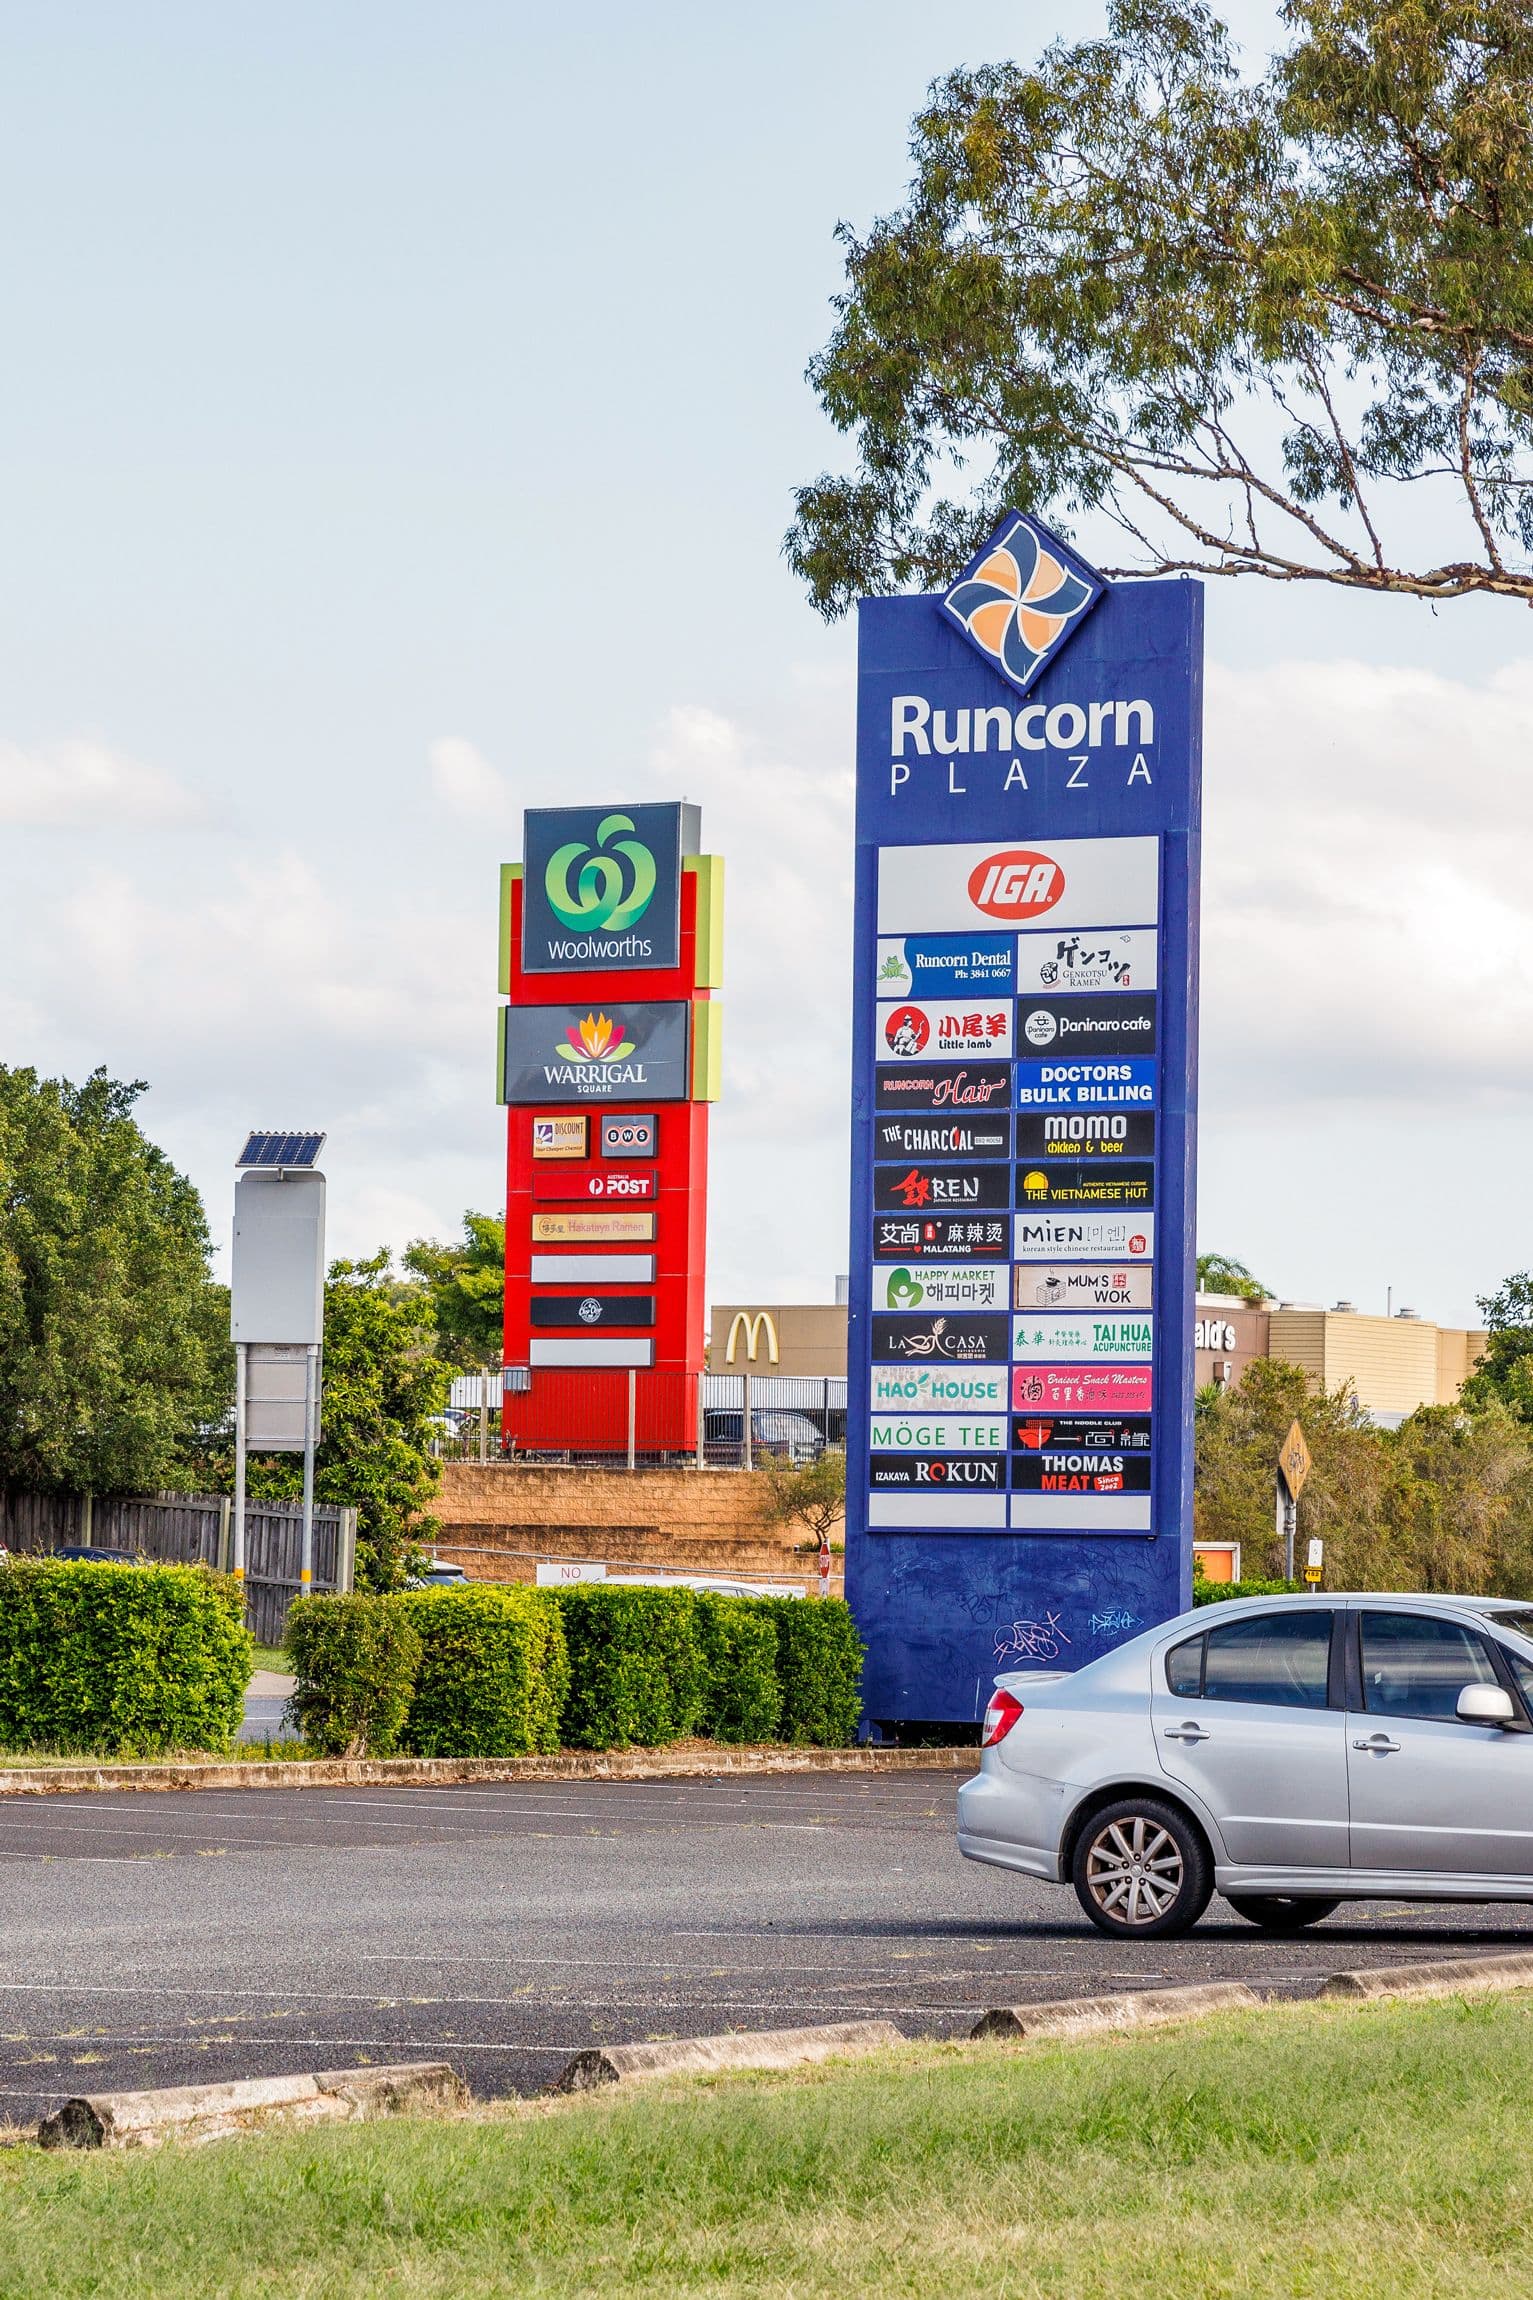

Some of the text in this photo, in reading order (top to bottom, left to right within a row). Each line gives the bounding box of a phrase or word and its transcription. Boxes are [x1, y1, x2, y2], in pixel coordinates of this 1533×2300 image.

[891, 695, 1153, 756] Runcorn
[891, 753, 1152, 796] PLAZA
[977, 864, 1057, 905] IGA
[548, 935, 652, 960] Woolworths
[915, 950, 1011, 968] Runcorn Dental
[1056, 936, 1131, 983] ゲンコツ
[955, 968, 1011, 979] Ph: 3841 0667
[938, 1013, 1007, 1038] 小尾羊
[1121, 1016, 1151, 1031] cafe
[938, 1039, 992, 1049] Little lamb
[544, 1063, 647, 1085] WARRIGAL
[1041, 1065, 1132, 1083] DOCTORS
[577, 1084, 612, 1093] SQUARE
[883, 1071, 1006, 1105] RUNCORN Hair
[1020, 1085, 1153, 1103] BULK BILLING
[555, 1122, 584, 1135] DISCOUNT
[609, 1129, 646, 1143] BWS
[882, 1124, 902, 1143] THE
[904, 1125, 974, 1151] CHARCOAL
[1047, 1140, 1124, 1154] chicken & beer
[606, 1179, 650, 1195] POST
[931, 1177, 979, 1198] REN
[1025, 1187, 1148, 1200] THE VIETNAMESE HUT
[923, 1245, 972, 1253] MALATANG
[1046, 1245, 1062, 1253] style
[915, 1270, 995, 1281] HAPPY MARKET
[926, 1283, 995, 1305] 해피마켓
[1094, 1290, 1132, 1303] WOK
[1092, 1324, 1116, 1342] TAI
[1120, 1324, 1151, 1341] HUA
[889, 1335, 987, 1349] LA CASA
[1093, 1342, 1151, 1352] ACUPUNCTURE
[1047, 1373, 1147, 1385] Braised Snack Masters
[877, 1382, 998, 1399] HAO HOUSE
[873, 1421, 1000, 1446] MÖGE TEE
[875, 1462, 998, 1482] IZAKAYA ROKUN
[1041, 1455, 1124, 1472] THOMAS
[1041, 1474, 1090, 1491] MEAT
[1097, 1476, 1119, 1485] Since
[561, 1567, 581, 1579] NO
